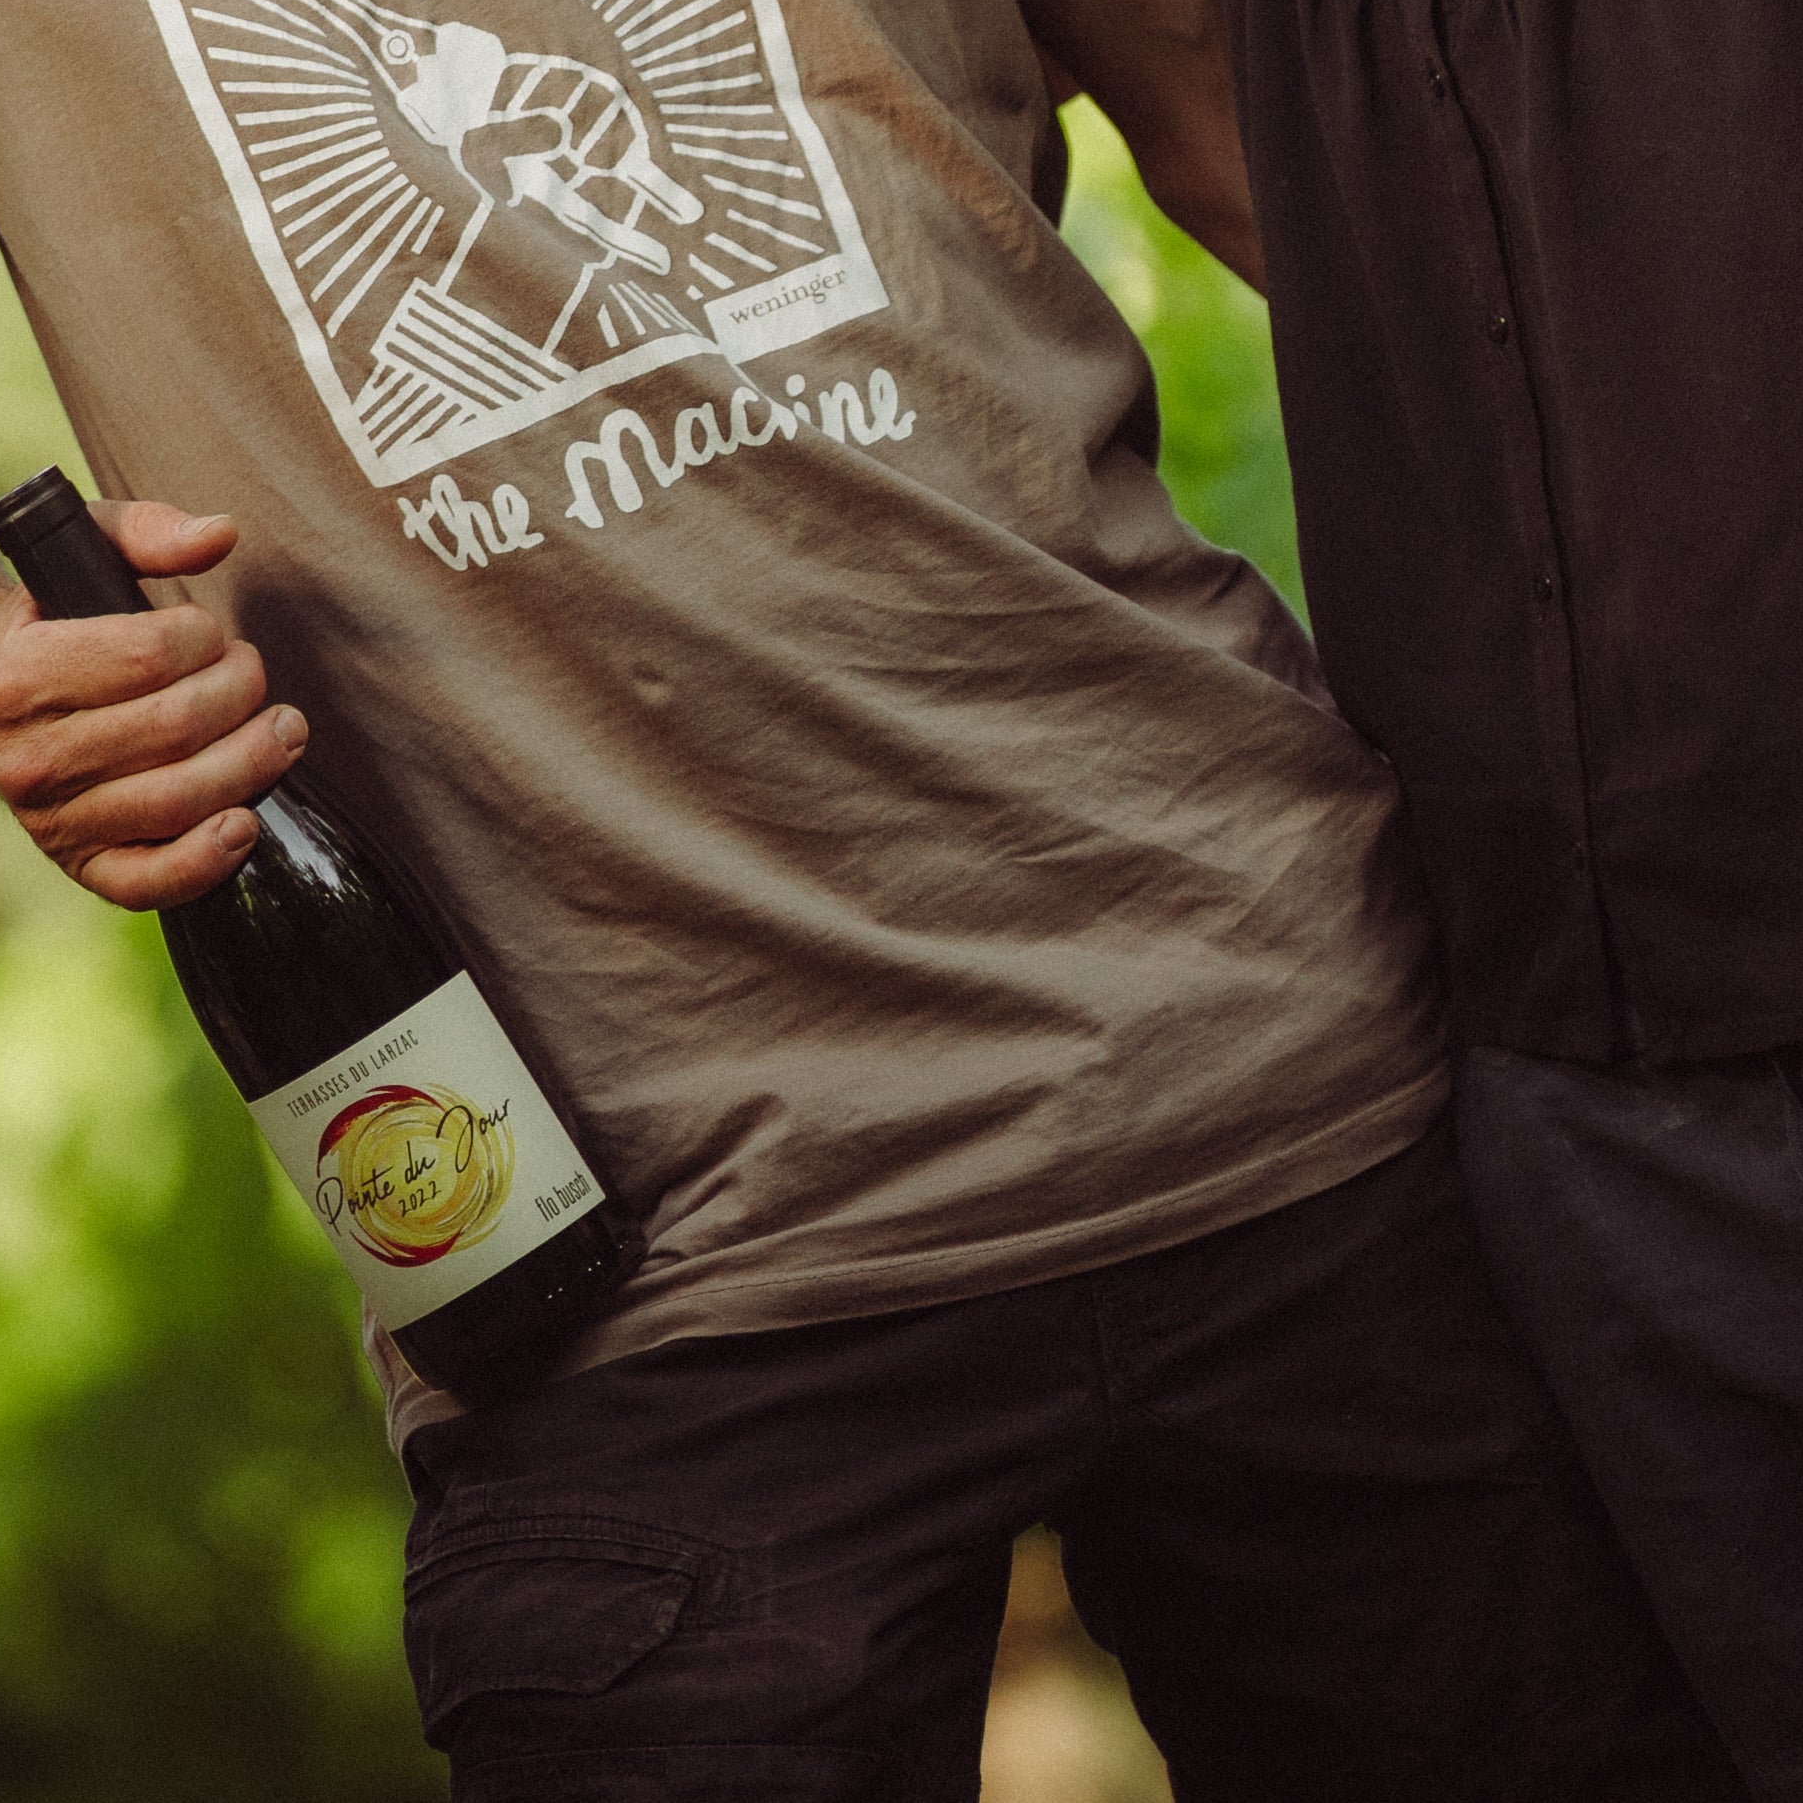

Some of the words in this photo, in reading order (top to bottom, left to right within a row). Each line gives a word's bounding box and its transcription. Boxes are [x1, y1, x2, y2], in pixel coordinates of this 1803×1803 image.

[729, 269, 846, 325] weninger
[396, 473, 546, 572] the
[564, 367, 917, 529] Macine
[286, 1072, 350, 1118] TERRASSES
[348, 1060, 370, 1083] DU
[369, 1029, 420, 1070] LARZAC
[316, 1166, 396, 1237] Pointe
[404, 1141, 436, 1185] du
[435, 1098, 510, 1174] Jour
[398, 1180, 443, 1218] 2022
[534, 1196, 561, 1223] flo
[552, 1170, 592, 1210] busch
